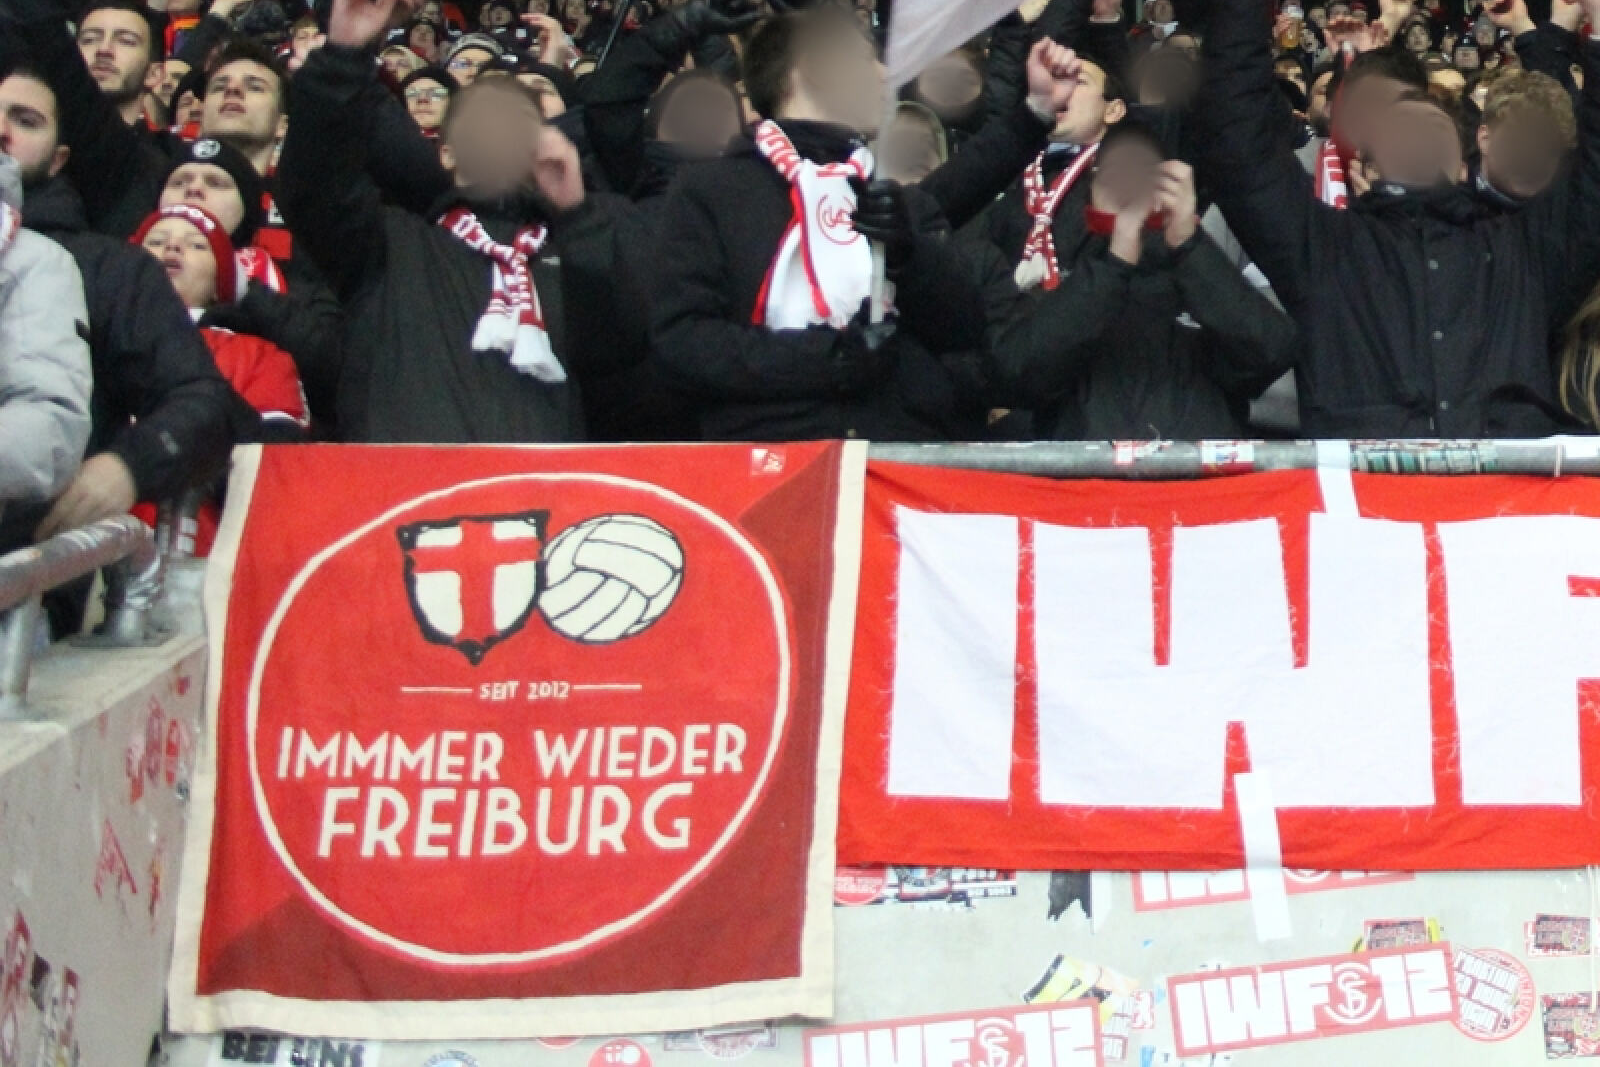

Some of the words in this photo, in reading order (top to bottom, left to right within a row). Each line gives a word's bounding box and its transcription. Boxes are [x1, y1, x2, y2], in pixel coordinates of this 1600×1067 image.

[479, 681, 519, 700] SEIT
[527, 680, 571, 700] 2012
[277, 727, 502, 783] IMMMER
[533, 723, 745, 777] WIEDER
[317, 781, 694, 859] FREIBURG
